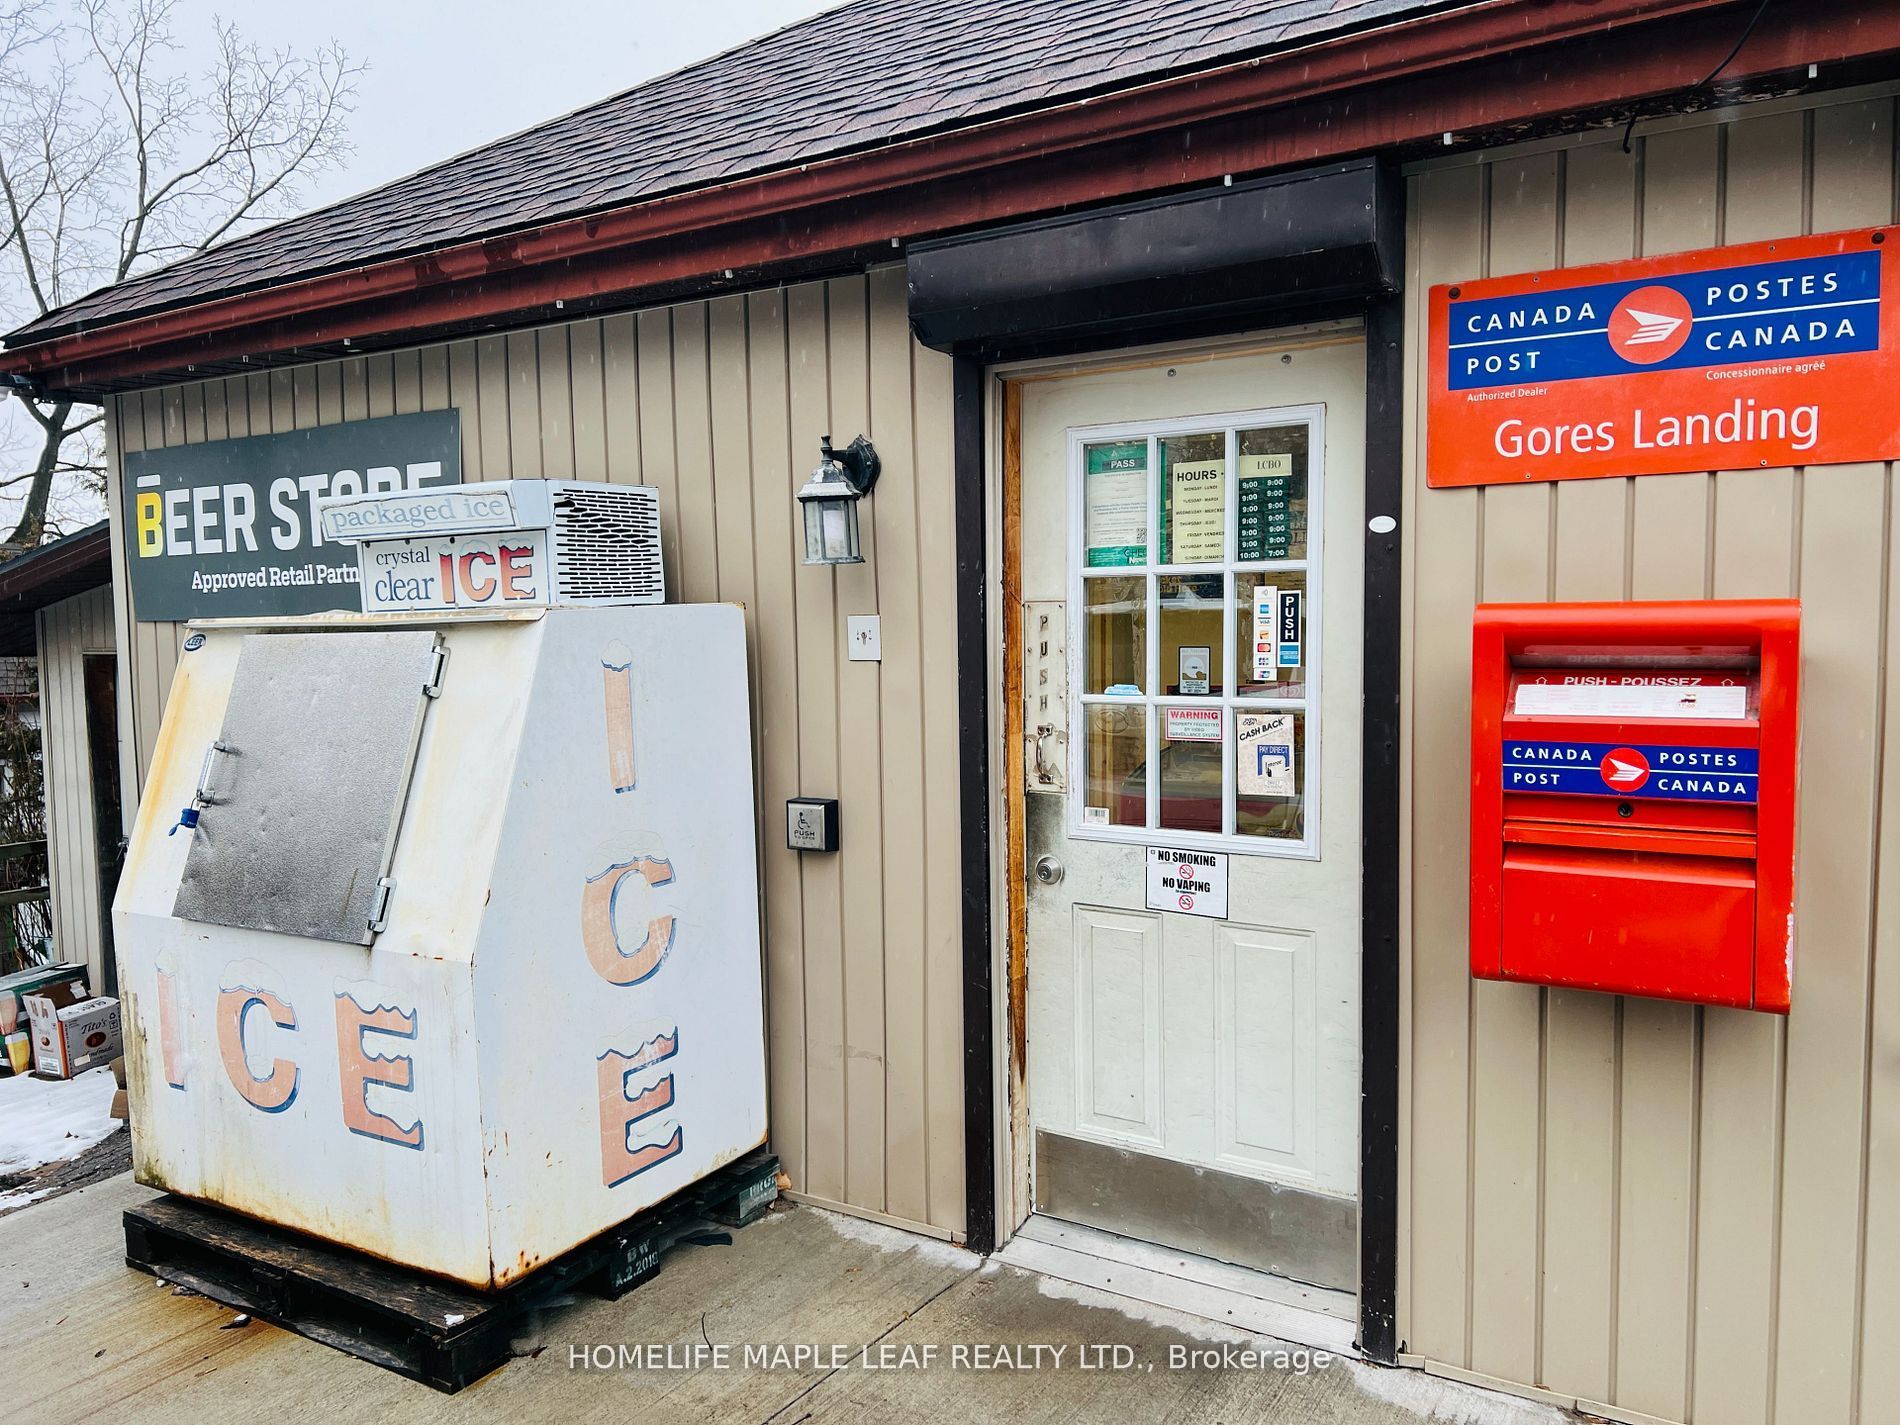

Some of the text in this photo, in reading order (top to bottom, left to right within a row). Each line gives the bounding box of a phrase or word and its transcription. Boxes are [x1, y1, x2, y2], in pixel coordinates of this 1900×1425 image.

[1707, 271, 1838, 306] POSTES
[1467, 302, 1596, 333] CANADA
[1705, 318, 1856, 351] CANADA
[1467, 351, 1541, 375] POST
[1706, 359, 1826, 381] Concessionnaire agréé
[1467, 387, 1548, 402] Authorized Dealer
[1494, 398, 1820, 458] Gores Landing
[1111, 459, 1135, 469] PASS
[1257, 460, 1281, 470] LCBO
[1177, 470, 1217, 482] HOURS
[1242, 481, 1258, 489] 9:00
[1242, 493, 1258, 502] 9:00
[136, 476, 259, 558] BEER
[331, 497, 505, 532] packaged ice
[1242, 505, 1258, 513] 9:00
[1241, 517, 1258, 525] 9:00
[1269, 525, 1285, 533] 9:00
[1242, 540, 1258, 548] 9:00
[376, 546, 431, 569] crystal
[1268, 549, 1285, 557] 7:00
[191, 566, 268, 593] Approved
[268, 563, 315, 587] Retail
[438, 541, 536, 604] ICE
[375, 571, 434, 601] clear
[1284, 596, 1295, 640] PUSH
[1040, 615, 1048, 712] PUSH
[1564, 676, 1607, 687] PUSH
[1621, 677, 1702, 687] POUSSEZ
[1170, 711, 1219, 720] WARNING
[1239, 718, 1284, 741] CASH BACK
[1259, 745, 1289, 754] PAY DIRECT
[1512, 747, 1592, 761] CANADA
[1659, 752, 1738, 767] POSTES
[1513, 773, 1561, 785] POST
[1658, 779, 1747, 795] CANADA
[1158, 850, 1216, 867] NO SMOKING
[1162, 877, 1174, 888] NO
[1176, 879, 1211, 893] VAPING
[581, 642, 683, 1189] ICE
[81, 1018, 108, 1034] Tito's
[154, 957, 426, 1151] ICE
